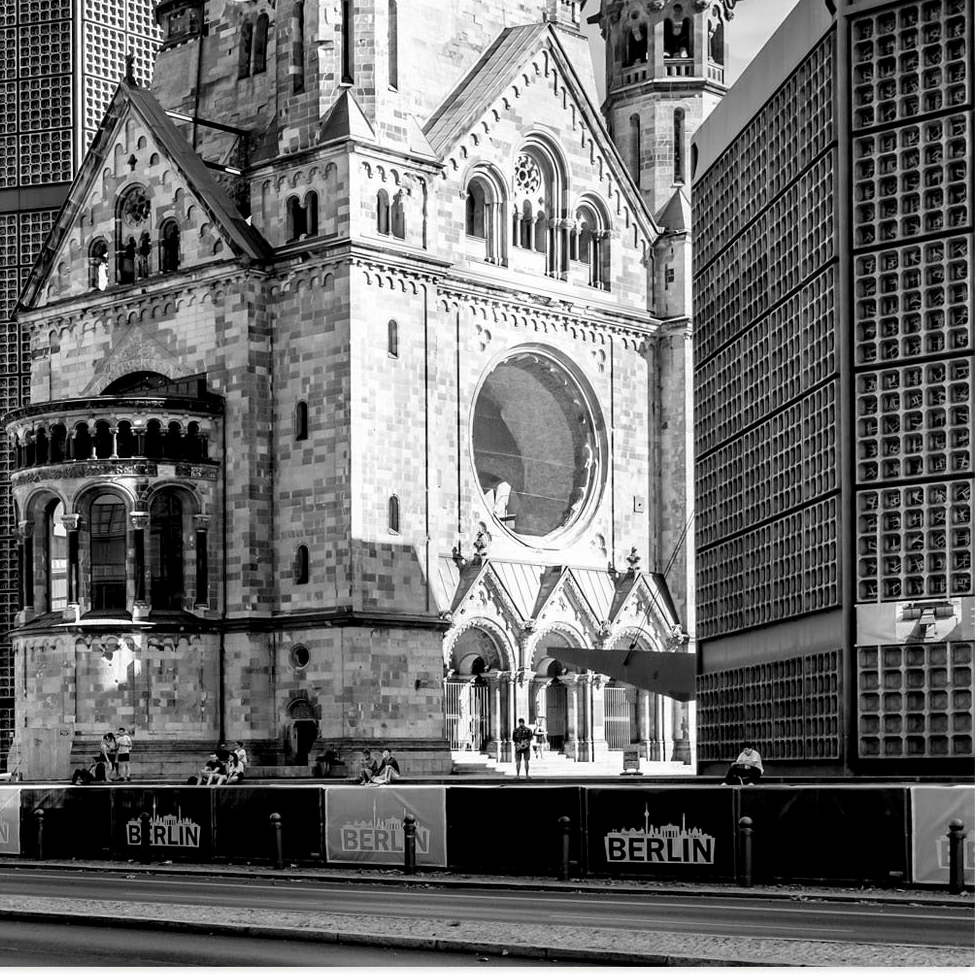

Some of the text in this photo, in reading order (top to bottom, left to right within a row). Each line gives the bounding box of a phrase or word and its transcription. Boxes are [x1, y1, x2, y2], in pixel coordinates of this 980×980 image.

[128, 824, 198, 846] BRLIN
[343, 829, 427, 852] BERLN
[608, 837, 711, 862] BERLIN
